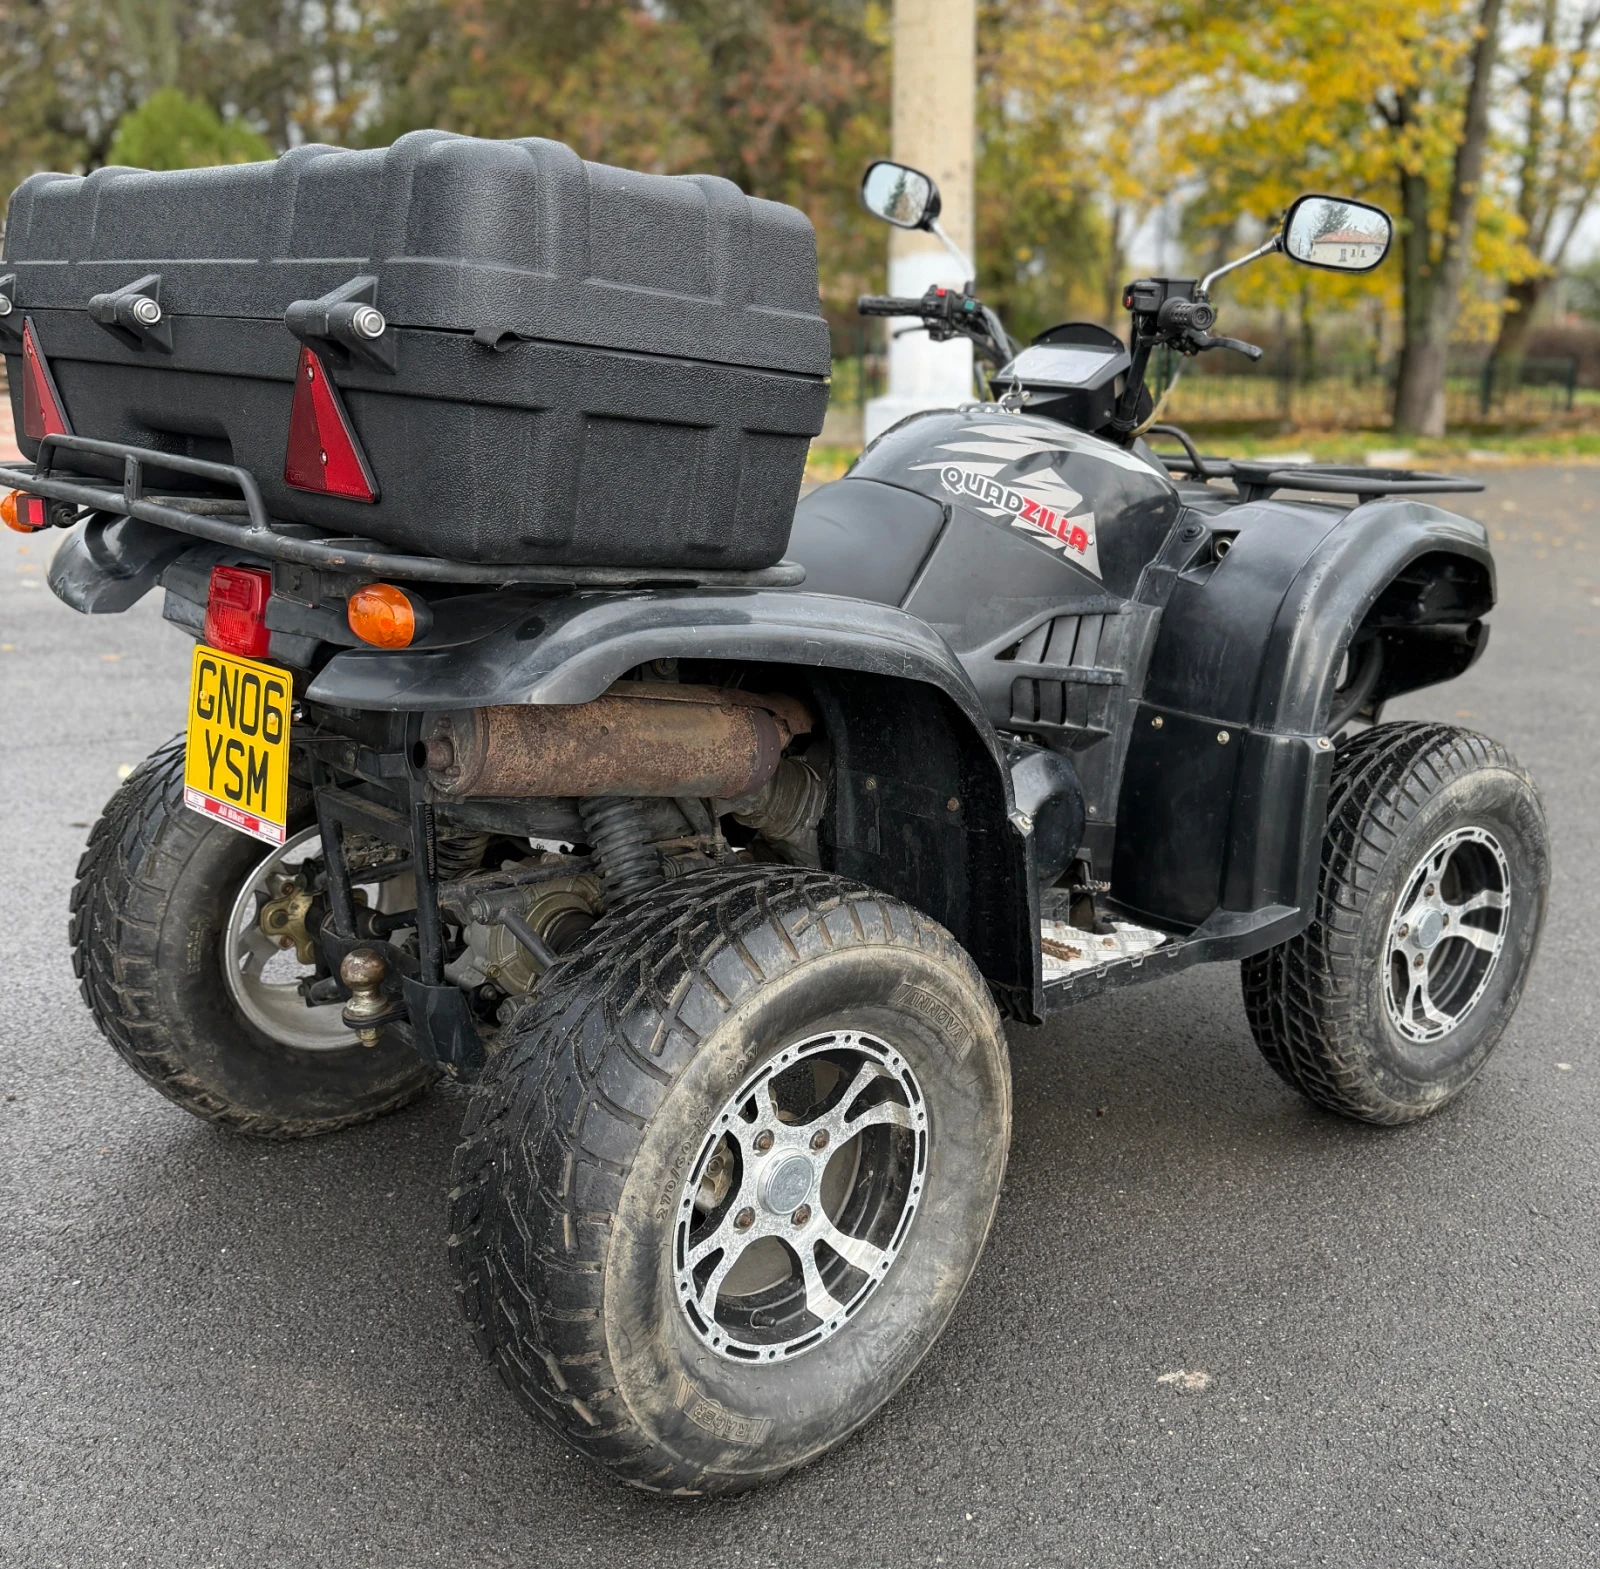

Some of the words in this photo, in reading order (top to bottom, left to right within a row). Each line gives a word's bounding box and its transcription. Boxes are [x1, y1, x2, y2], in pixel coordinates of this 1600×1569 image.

[941, 465, 1090, 555] QUADZILLA
[198, 660, 284, 744] GN06
[205, 728, 270, 813] YSM
[228, 808, 245, 825] Bikes
[910, 991, 964, 1042] INNOVA
[655, 1105, 711, 1220] 270/60-12
[693, 1402, 749, 1438] RACER
